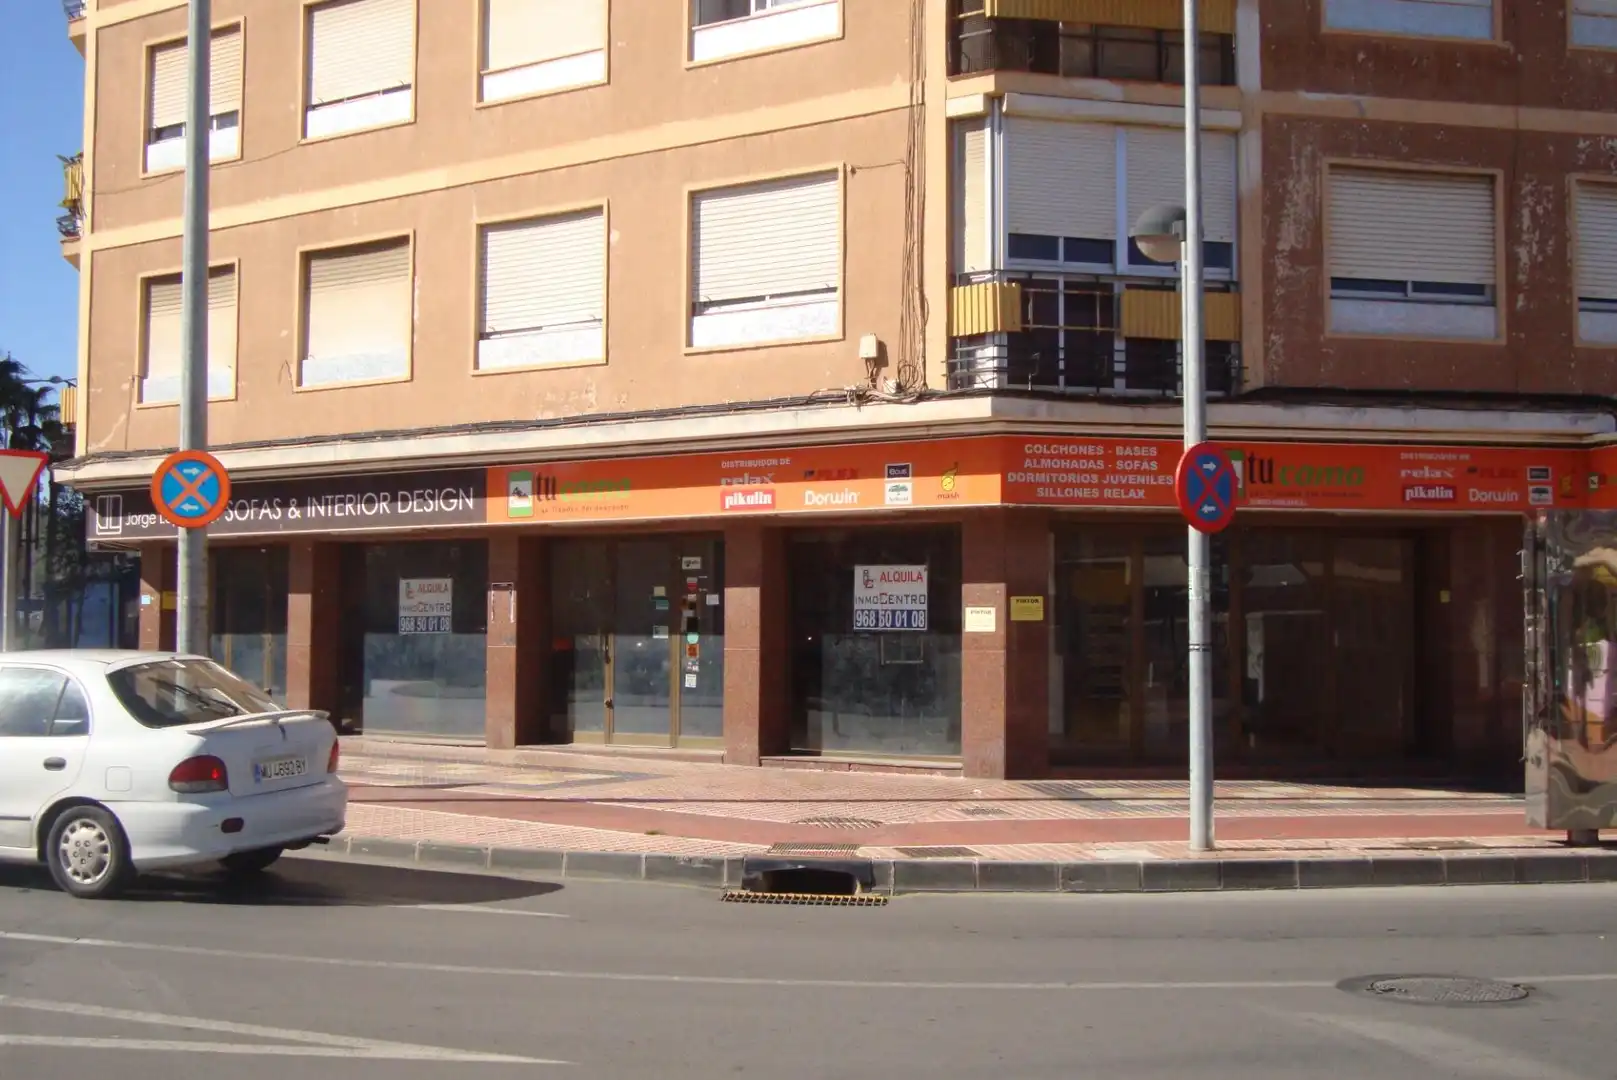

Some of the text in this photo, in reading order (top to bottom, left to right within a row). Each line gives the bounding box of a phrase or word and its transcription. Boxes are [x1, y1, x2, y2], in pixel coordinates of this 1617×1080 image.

[1024, 444, 1104, 455] COLCHONES
[1116, 445, 1157, 457] BASES
[721, 457, 791, 469] DISTRIBUIDOR DE
[1024, 459, 1104, 470] ALMOHADAS
[1116, 459, 1158, 471] SOFAS
[1007, 472, 1174, 485] DORMITORIOS JUVENILES
[804, 488, 858, 505] Dorwin
[1037, 487, 1145, 499] SILLONES RELAX
[1468, 488, 1519, 502] Dorwin
[225, 488, 474, 522] SOFAS & INTERIOR DESIGN
[125, 513, 156, 528] Jorge
[880, 571, 923, 583] ALQUILA
[417, 583, 448, 593] ALQUILA
[855, 592, 926, 605] INMOCENTRO
[400, 616, 415, 632] 968
[856, 610, 876, 627] 968
[895, 611, 908, 627] 01
[911, 611, 925, 627] 08
